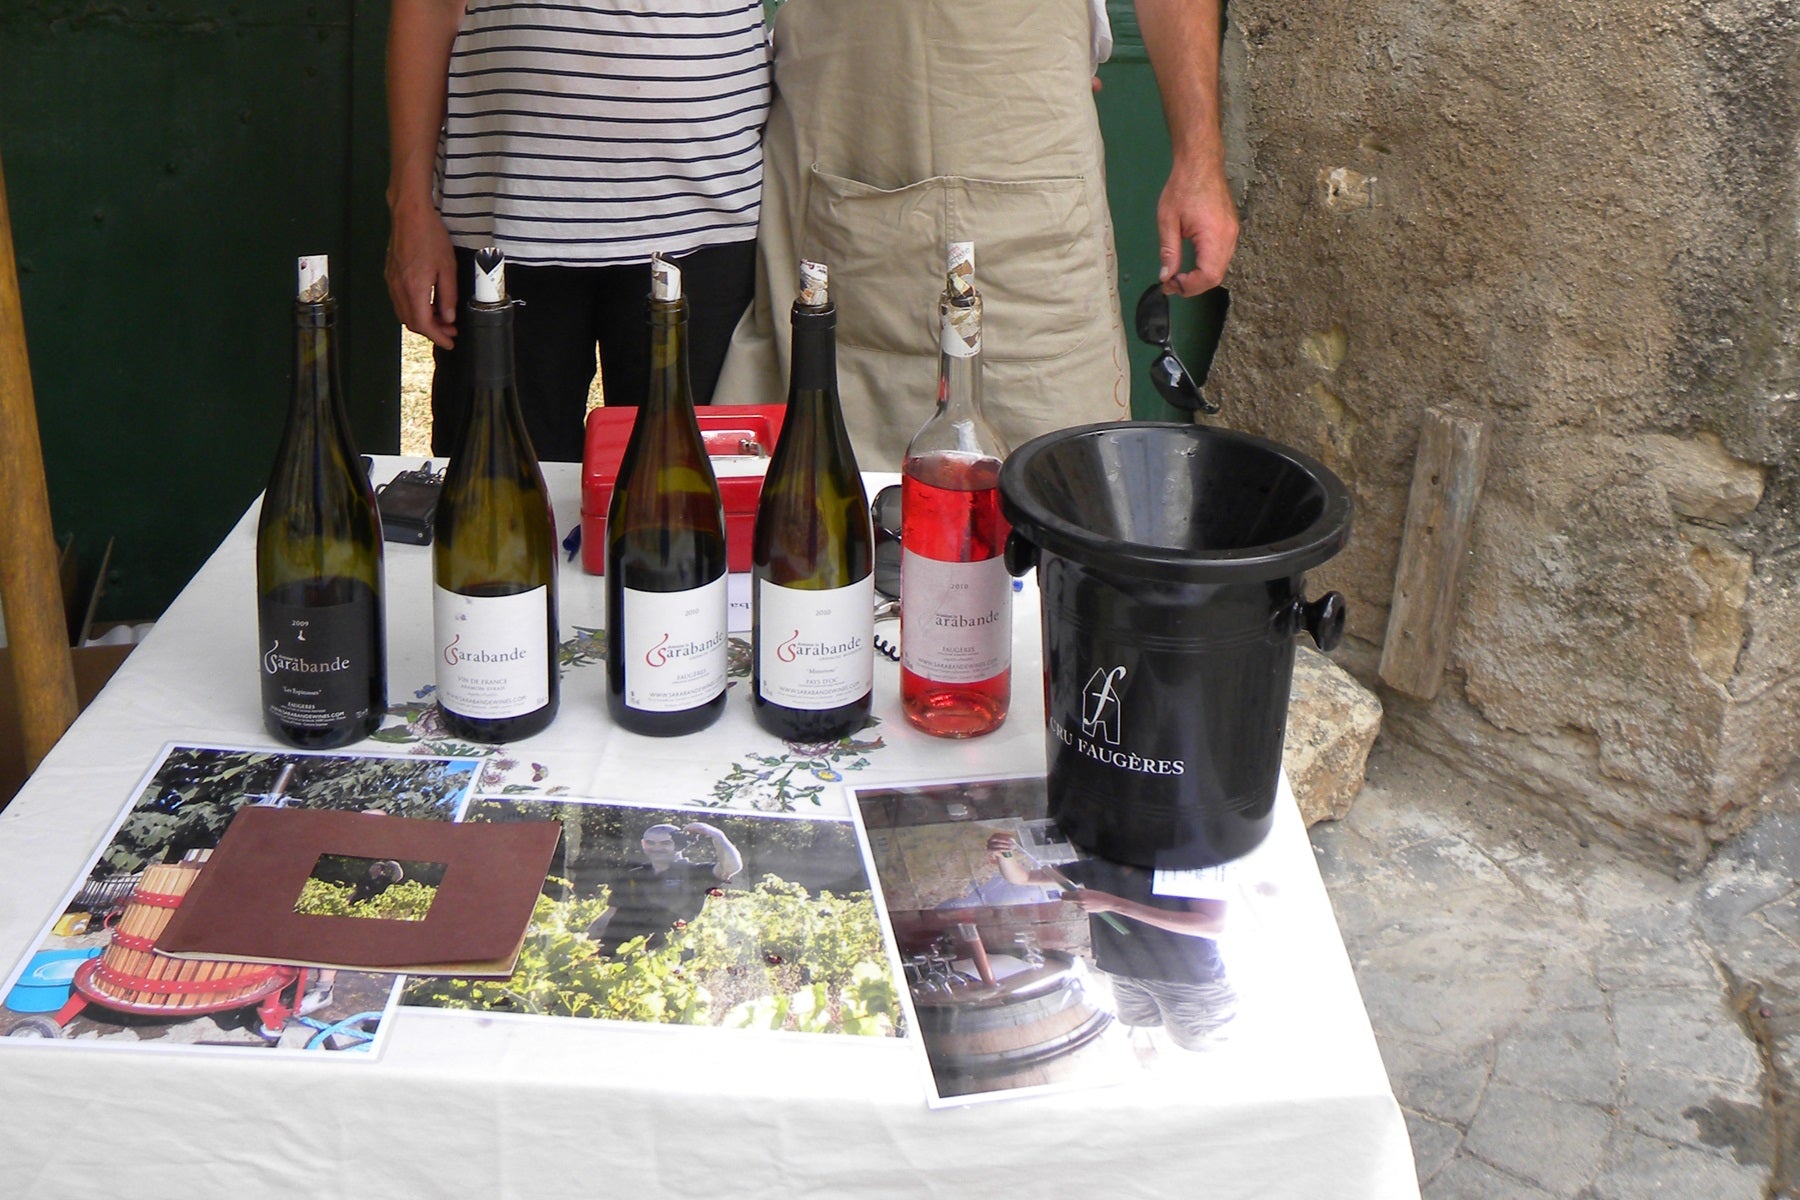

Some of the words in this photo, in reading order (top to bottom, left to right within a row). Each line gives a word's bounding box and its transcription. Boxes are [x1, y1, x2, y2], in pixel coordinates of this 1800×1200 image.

[935, 610, 1000, 628] arabande
[264, 639, 350, 674] Sarabande
[443, 633, 527, 666] Sarabande
[645, 631, 724, 668] Sarabande
[777, 629, 862, 663] Sarabande
[1050, 716, 1073, 745] CRU
[1078, 738, 1185, 775] FAUGÈRES
